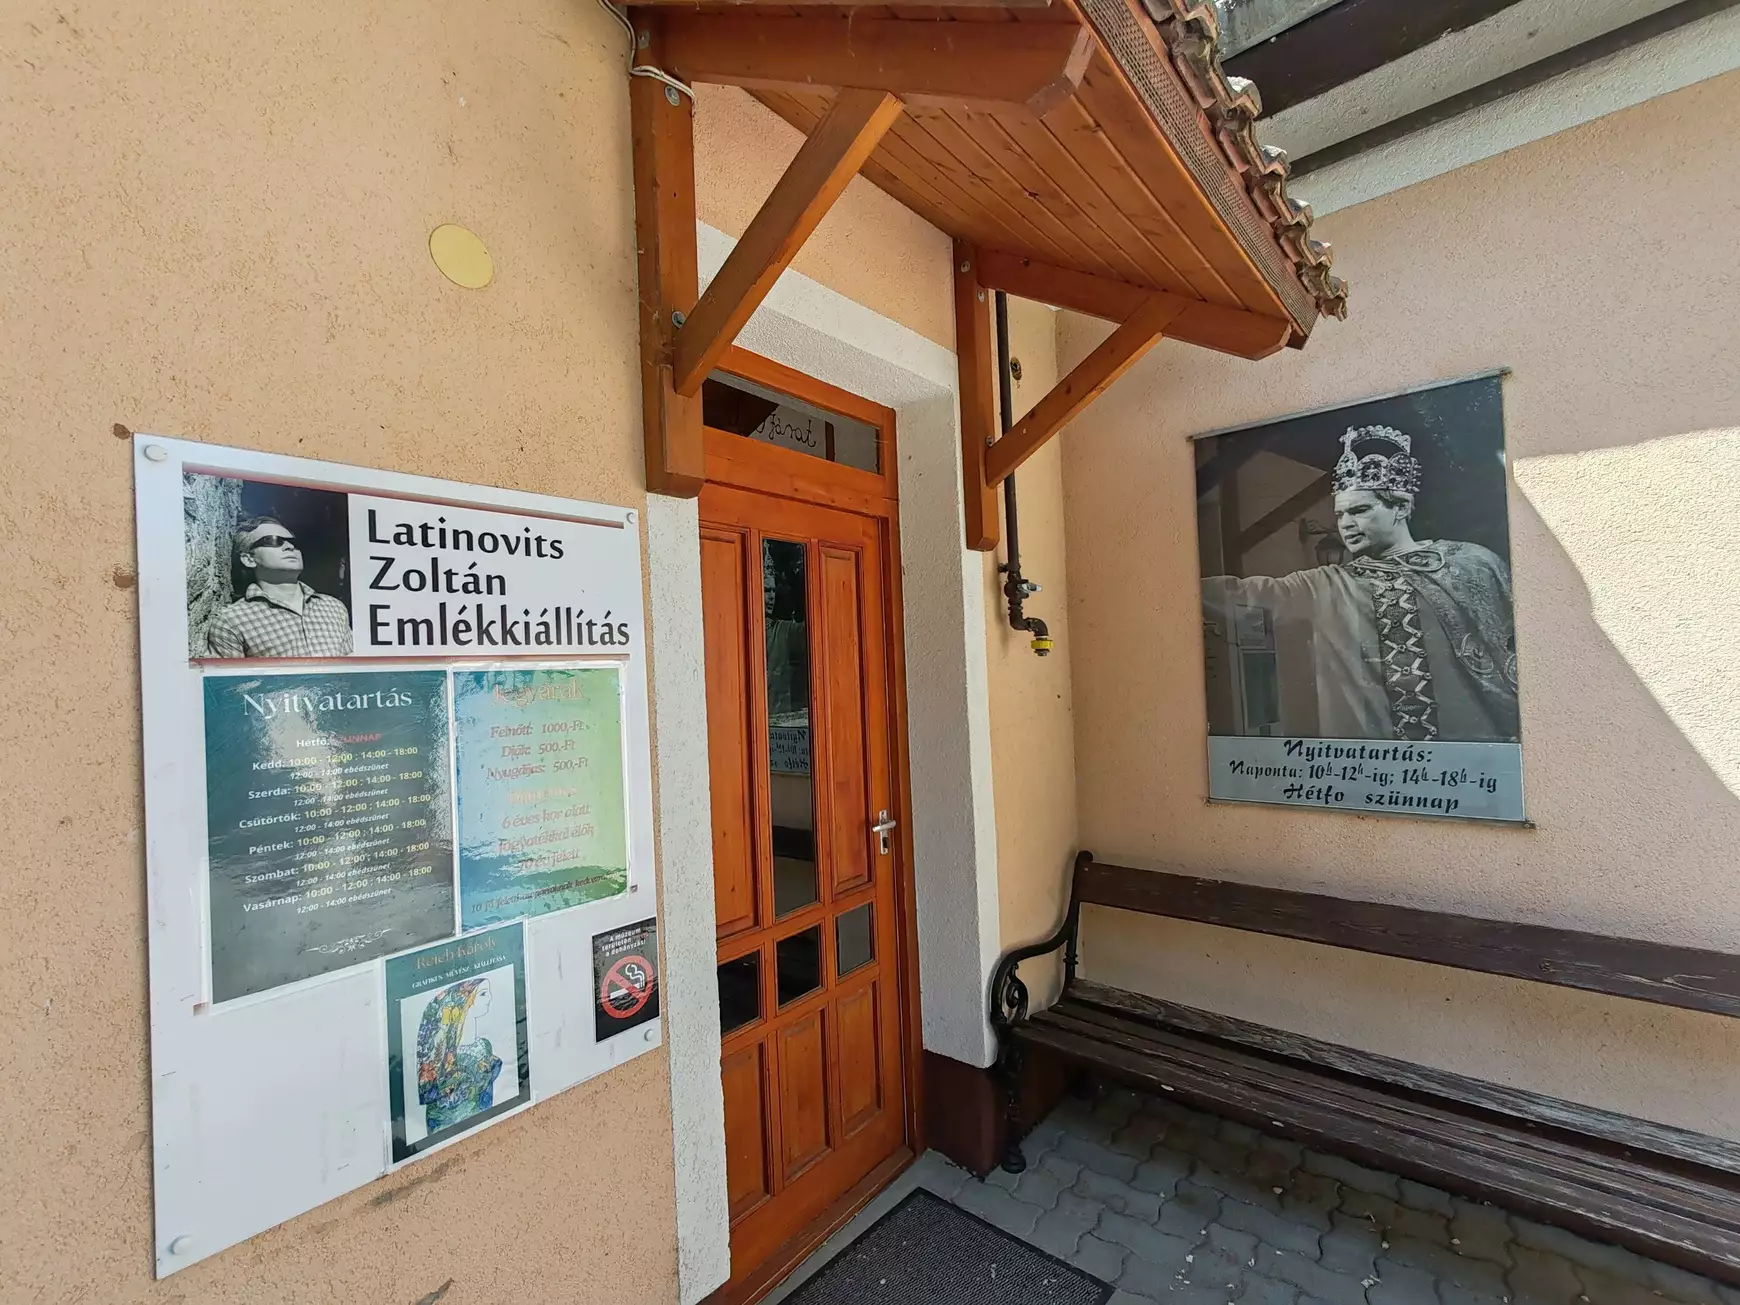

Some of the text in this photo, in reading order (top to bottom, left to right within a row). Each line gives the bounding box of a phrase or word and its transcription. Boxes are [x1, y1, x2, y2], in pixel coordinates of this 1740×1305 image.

[367, 507, 565, 560] Latinovits
[368, 555, 508, 597] Zoltán
[369, 602, 631, 648] Emlékkiállítás
[243, 687, 413, 720] Nyitvatartás
[252, 760, 285, 771] Kedd:
[289, 756, 317, 767] 10:00
[326, 753, 353, 763] 12:00
[360, 749, 386, 759] 14:00
[393, 747, 418, 756] 18:00
[1283, 739, 1433, 762] Nyitvatartás:
[248, 788, 291, 799] Szerda:
[294, 783, 322, 794] 10:00
[331, 779, 358, 789] 12:00
[366, 774, 391, 784] 14:00
[399, 771, 423, 780] 18:00
[1229, 760, 1303, 779] Naponta:
[239, 812, 301, 828] Csütörtök:
[304, 807, 332, 818] 10:00
[341, 802, 367, 813] 12:00
[375, 798, 400, 808] 14:00
[407, 794, 431, 803] 18:00
[1283, 783, 1460, 814] Hétfo szünnap
[249, 841, 294, 855] Péntek:
[297, 835, 325, 846] 10:00
[335, 829, 360, 840] 12:00
[369, 823, 394, 834] 14:00
[401, 819, 425, 829] 18:00
[245, 867, 299, 884] Szombat:
[303, 860, 330, 872] 10:00
[339, 854, 365, 865] 12:00
[374, 848, 398, 859] 14:00
[406, 842, 430, 853] 18:00
[243, 894, 302, 912] Vasárnap:
[305, 886, 333, 898] 10:00
[342, 879, 368, 891] 12:00
[376, 872, 401, 883] 14:00
[408, 866, 432, 876] 18:00
